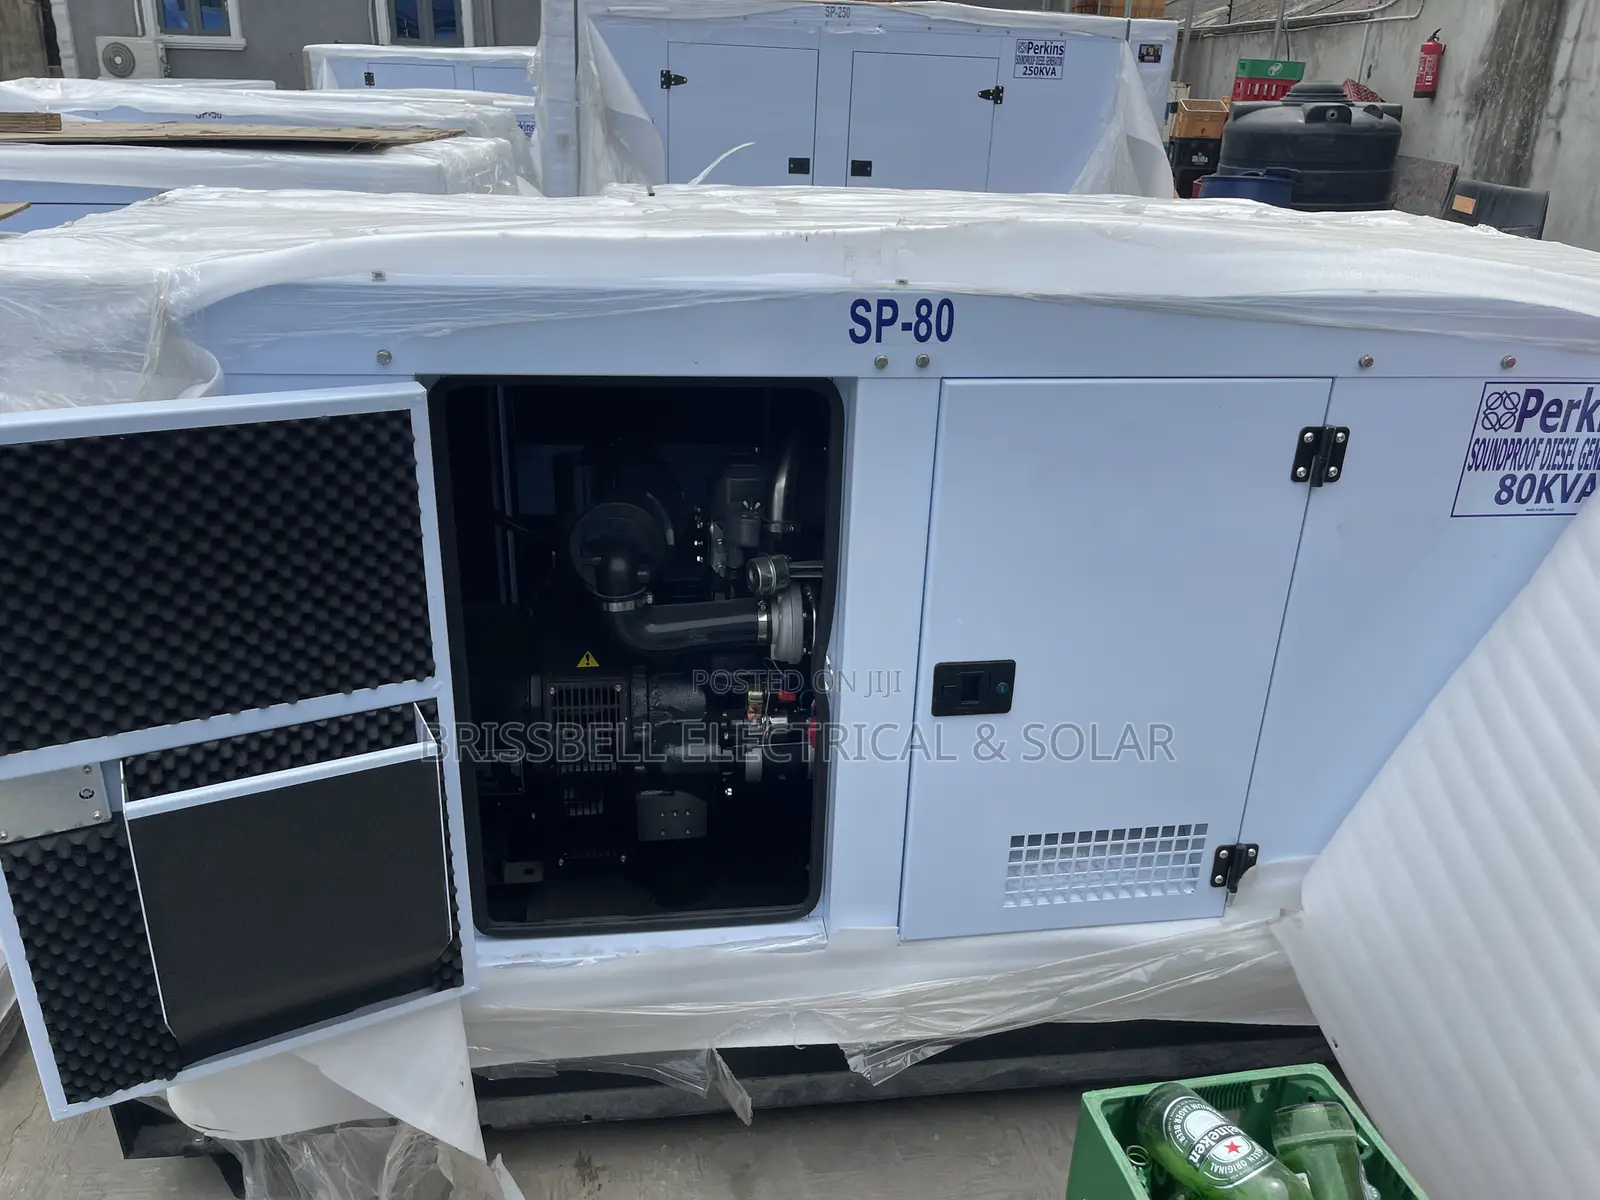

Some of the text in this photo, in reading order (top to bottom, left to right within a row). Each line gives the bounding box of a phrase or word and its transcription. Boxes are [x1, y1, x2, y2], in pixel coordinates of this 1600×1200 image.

[825, 5, 850, 18] SP-250
[1027, 41, 1064, 55] Perkins
[1022, 66, 1056, 76] 250KVA
[849, 298, 954, 344] SP-80
[1514, 387, 1600, 433] Perk
[1467, 437, 1600, 472] SOUNDPROOF DIESEL GEN
[1494, 473, 1597, 505] 80KVA
[1174, 1106, 1192, 1124] LAGER
[1173, 1124, 1186, 1144] BEER
[1189, 1125, 1240, 1164] eineken
[1210, 1161, 1248, 1175] ORIGINAL
